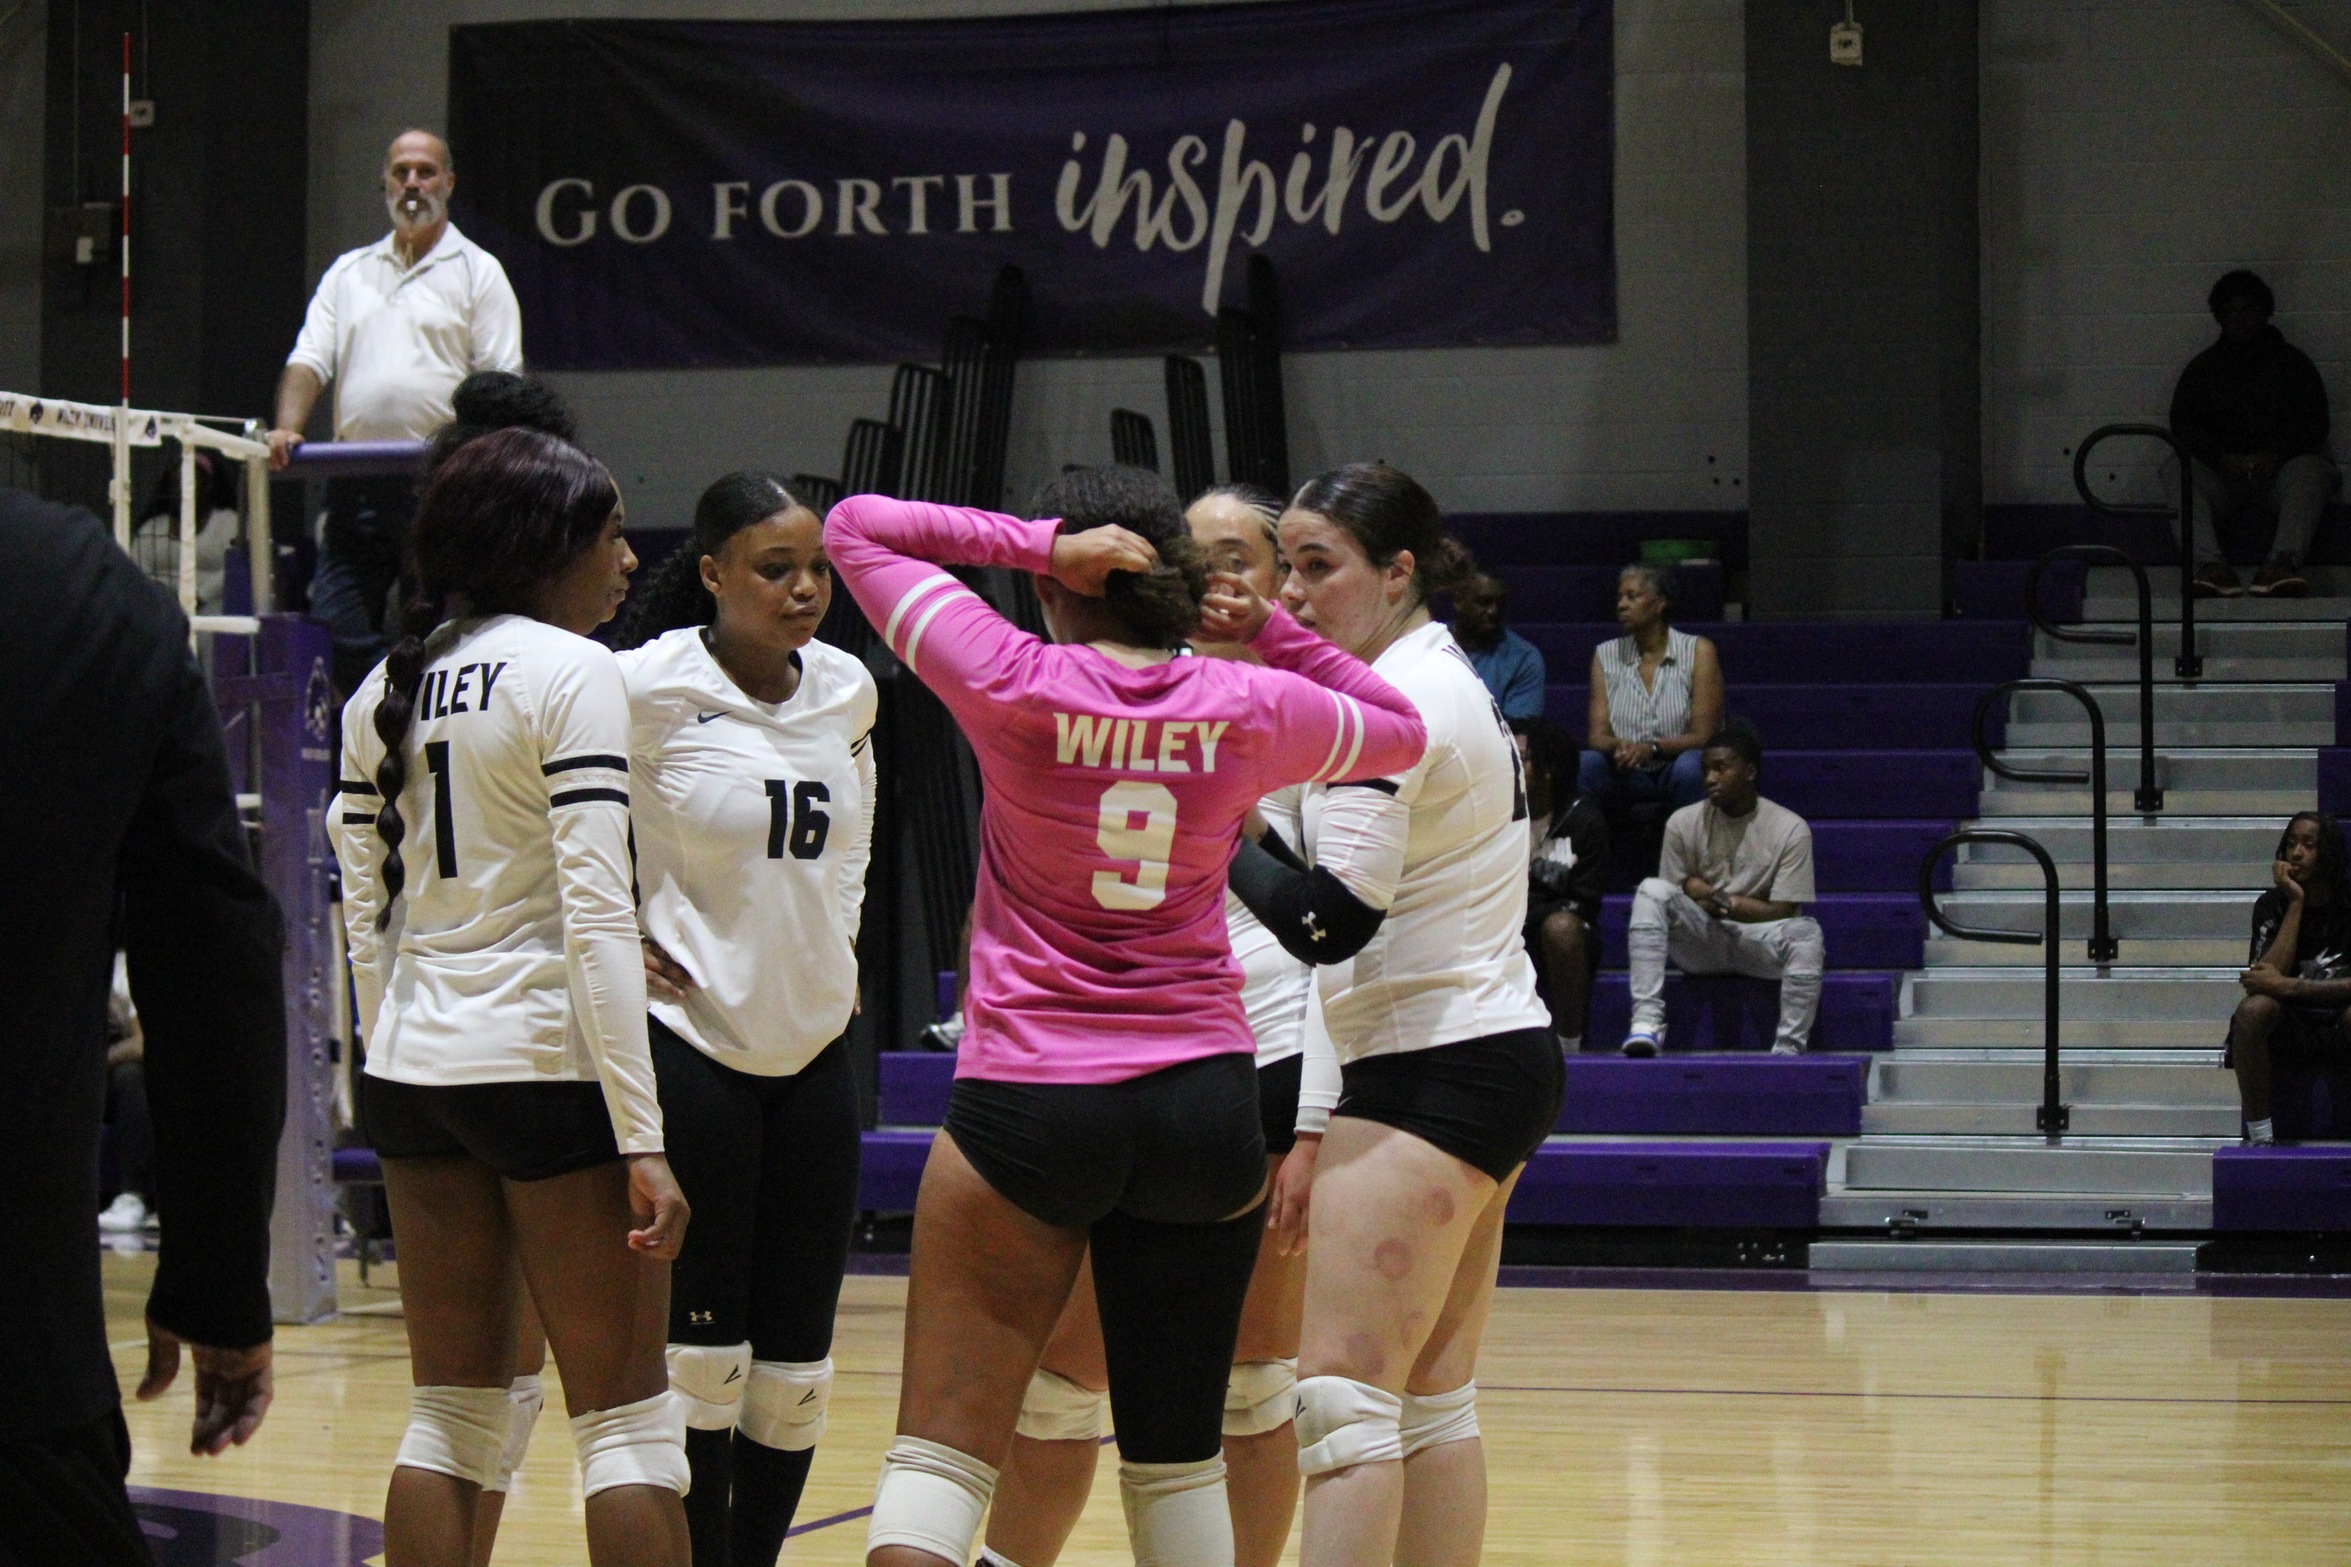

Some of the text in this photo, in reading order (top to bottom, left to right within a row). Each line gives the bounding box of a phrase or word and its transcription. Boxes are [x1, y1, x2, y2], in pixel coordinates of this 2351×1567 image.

[534, 62, 1525, 317] GO FORTH inspired.
[1053, 713, 1230, 773] WILEY
[424, 740, 458, 879] 1
[764, 779, 831, 859] 16
[1090, 780, 1178, 911] 9
